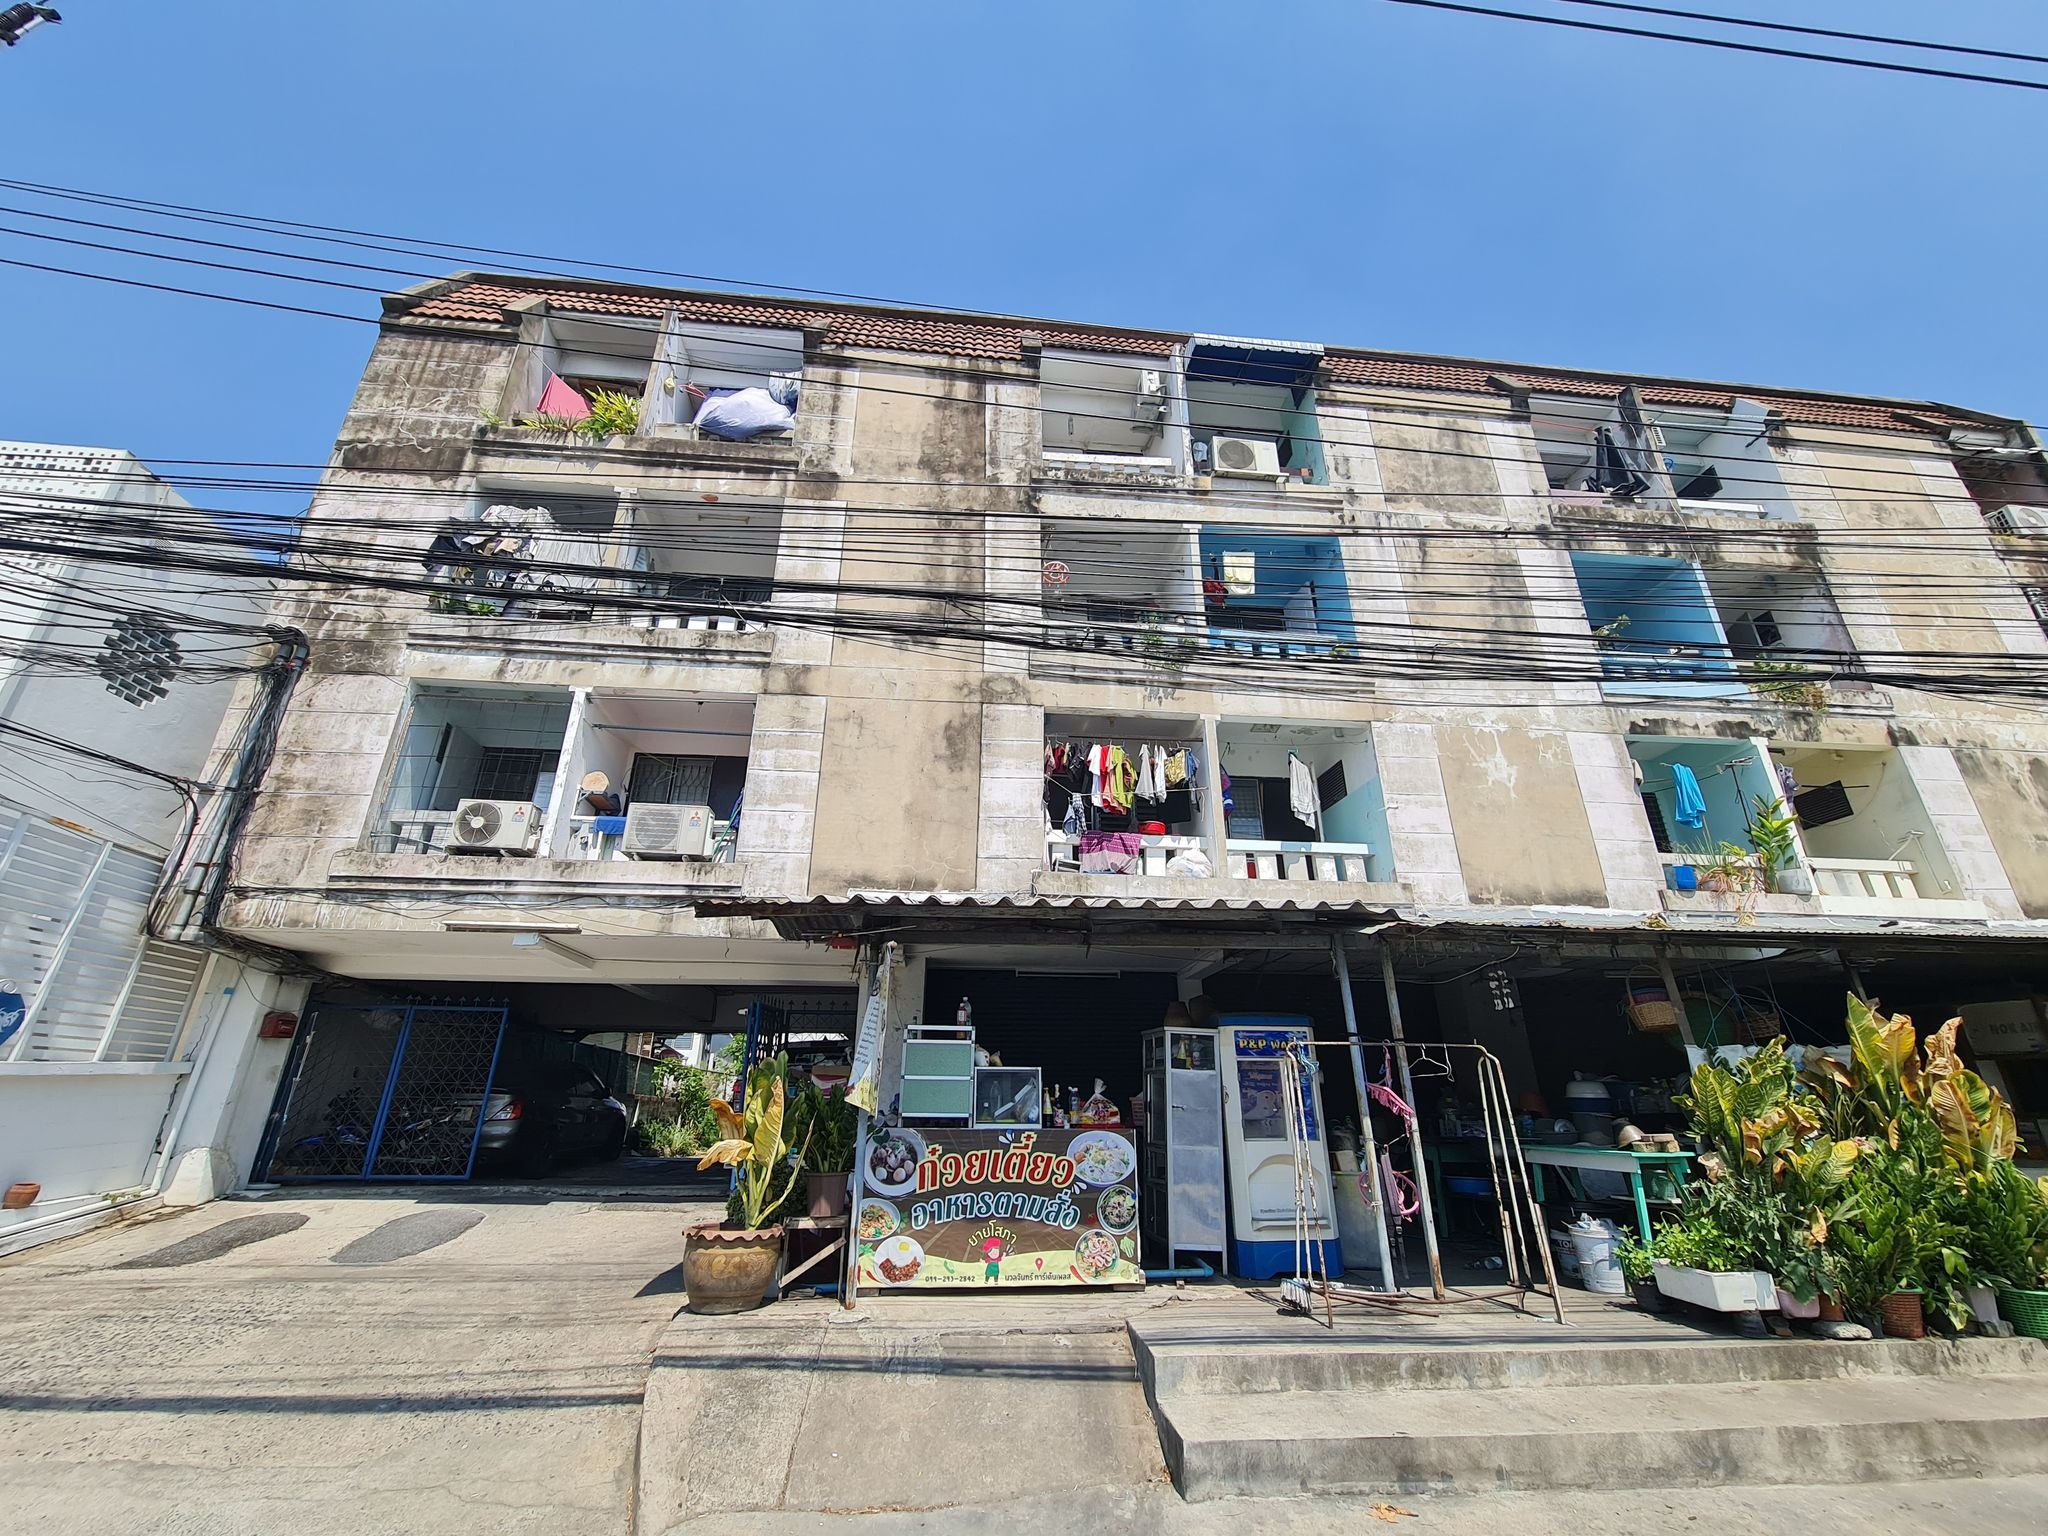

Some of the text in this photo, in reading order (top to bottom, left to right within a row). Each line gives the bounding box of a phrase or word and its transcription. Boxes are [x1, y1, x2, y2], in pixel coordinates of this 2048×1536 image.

[1239, 1038, 1267, 1049] P&P
[917, 1132, 1076, 1193] ก๋วยเตี๋ยว
[912, 1189, 1080, 1230] อาหารตามสั่ง
[968, 1219, 1017, 1246] ยายโสภา
